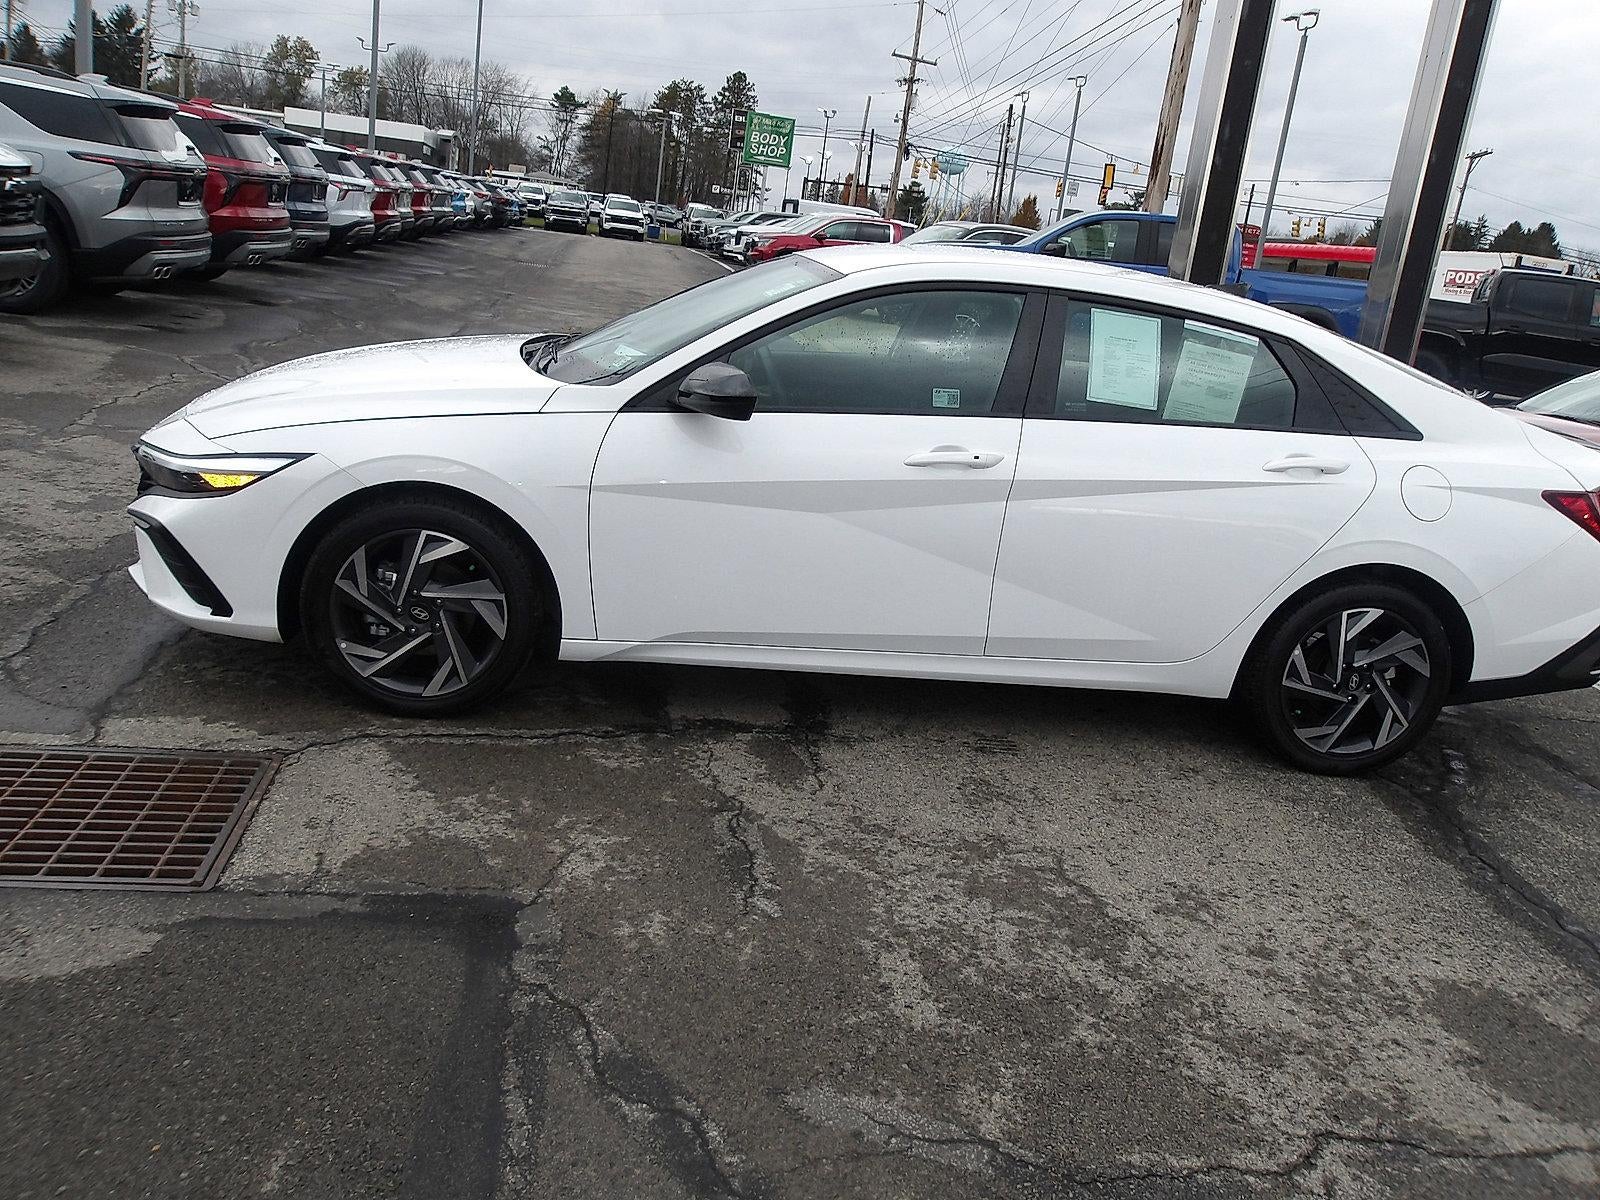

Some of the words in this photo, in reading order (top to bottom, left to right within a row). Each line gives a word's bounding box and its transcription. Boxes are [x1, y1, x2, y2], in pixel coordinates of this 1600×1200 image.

[750, 132, 788, 146] BODY
[750, 144, 786, 157] SHOP
[1445, 271, 1484, 284] PODS
